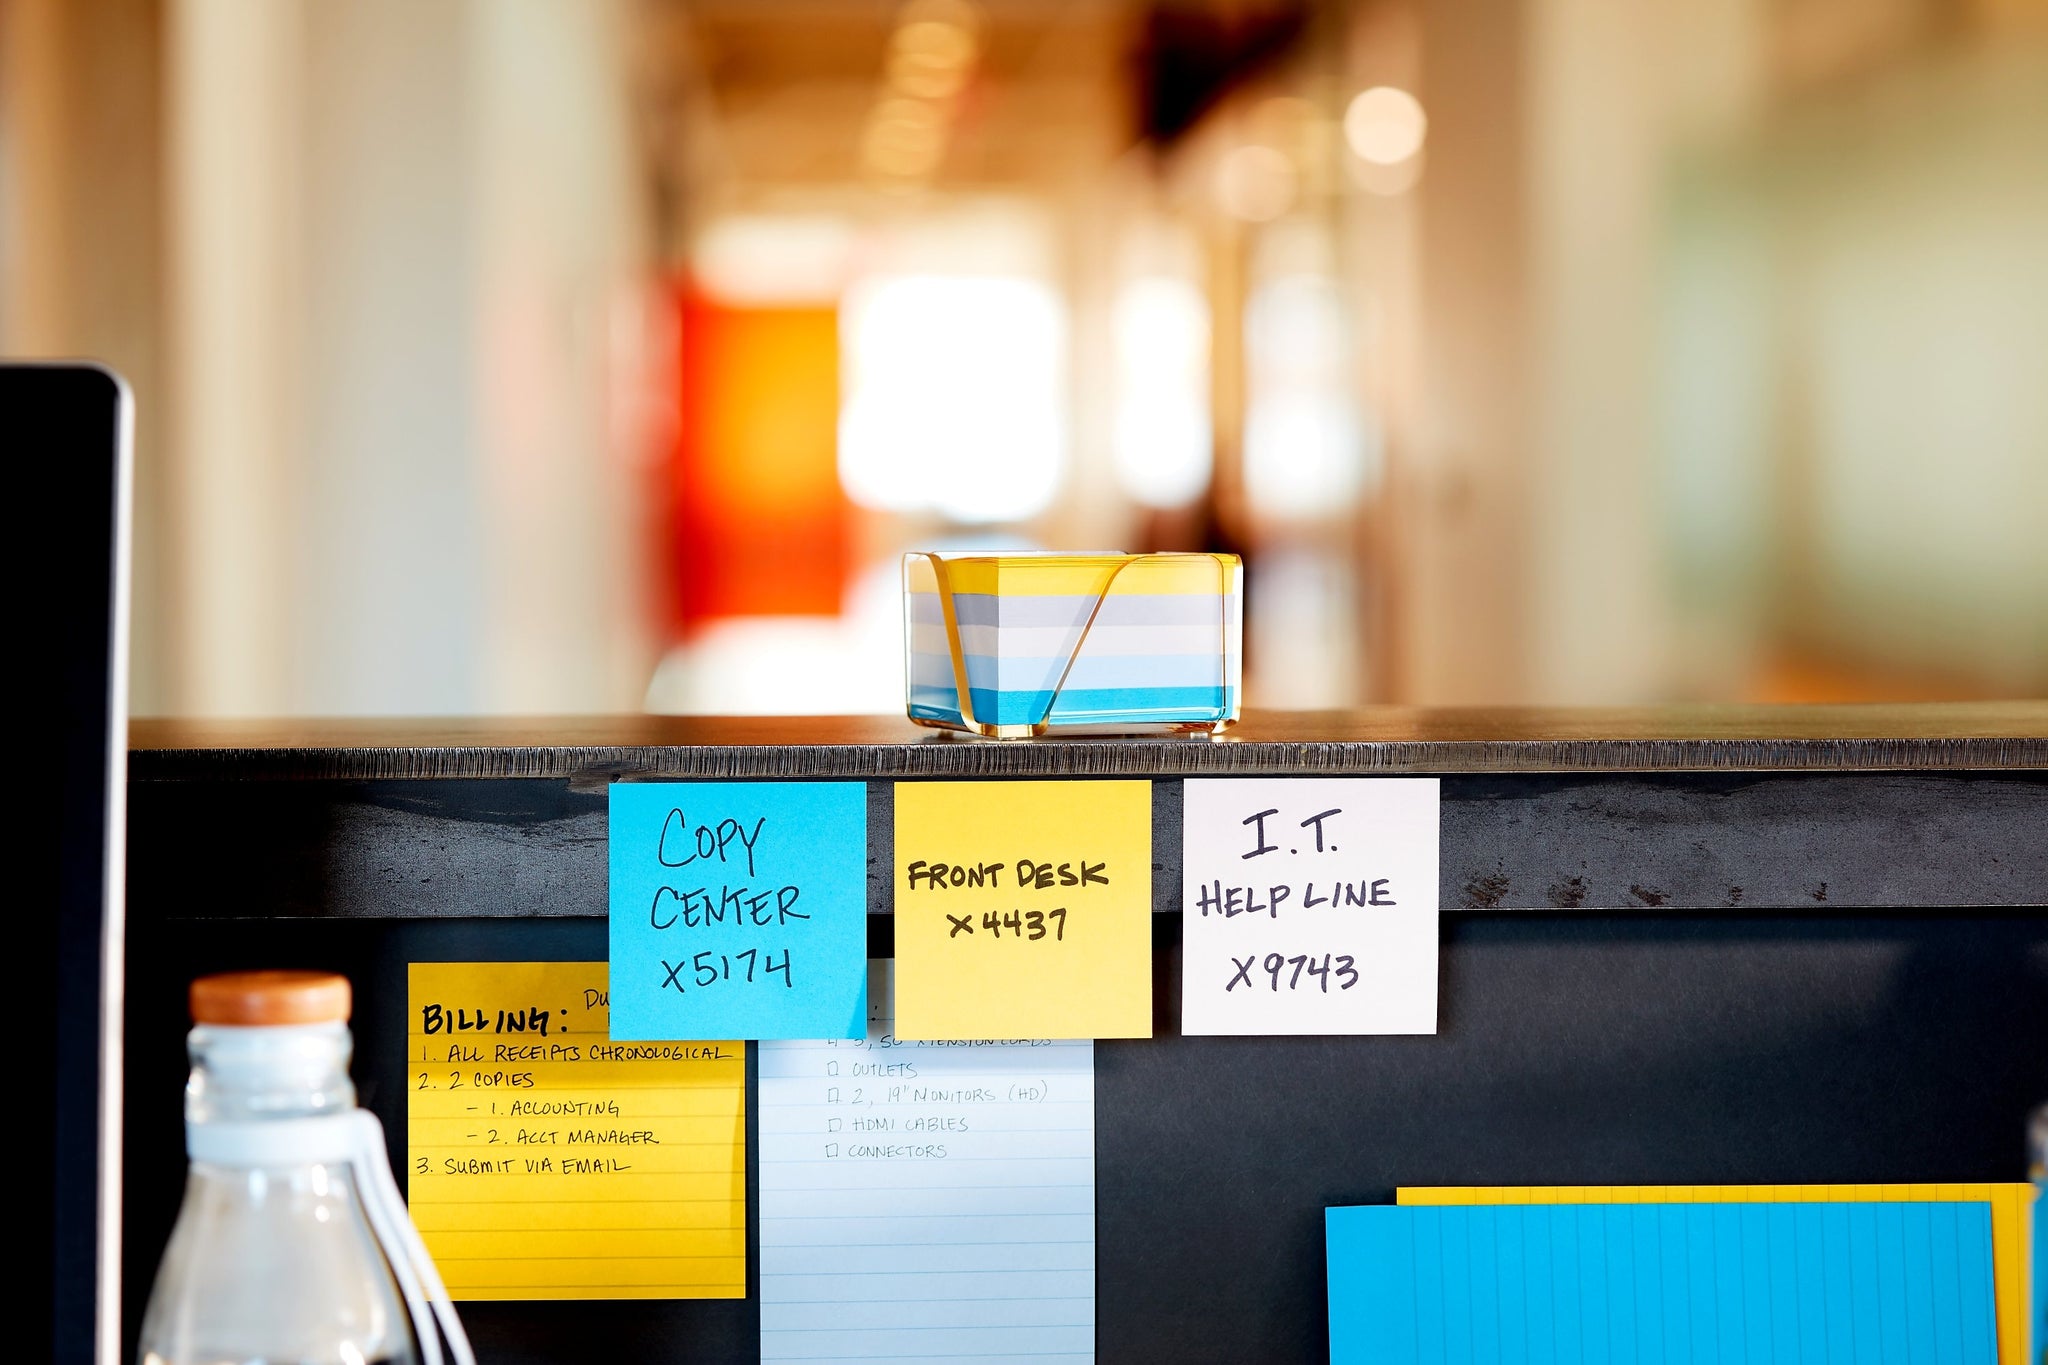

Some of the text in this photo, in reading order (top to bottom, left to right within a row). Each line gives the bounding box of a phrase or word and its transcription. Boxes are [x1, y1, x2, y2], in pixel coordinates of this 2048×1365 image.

[658, 807, 767, 878] COPY
[1240, 808, 1343, 860] I.T.
[907, 858, 1110, 891] FRONT DESK
[650, 884, 811, 930] CENTER
[1195, 878, 1398, 919] HELP LINE
[421, 1003, 568, 1038] BILLING:
[447, 1044, 485, 1063] ALL
[494, 1044, 581, 1063] RECEIPTS
[589, 1044, 733, 1062] CHRONOLOGICAL
[852, 1062, 918, 1077] OUTLETS
[418, 1070, 535, 1091] 2. 2 COPIES
[912, 1086, 997, 1103] MONITORS
[1007, 1079, 1049, 1105] (HD)
[510, 1099, 620, 1119] ACCOUNTING
[852, 1117, 969, 1133] HDMI CABLES
[487, 1129, 508, 1145] 2.
[516, 1128, 559, 1145] ACCT
[567, 1129, 660, 1146] MANAGER
[848, 1144, 947, 1159] CONNECTORS
[416, 1156, 632, 1175] 3. SUBMIT VIA EMAIL
